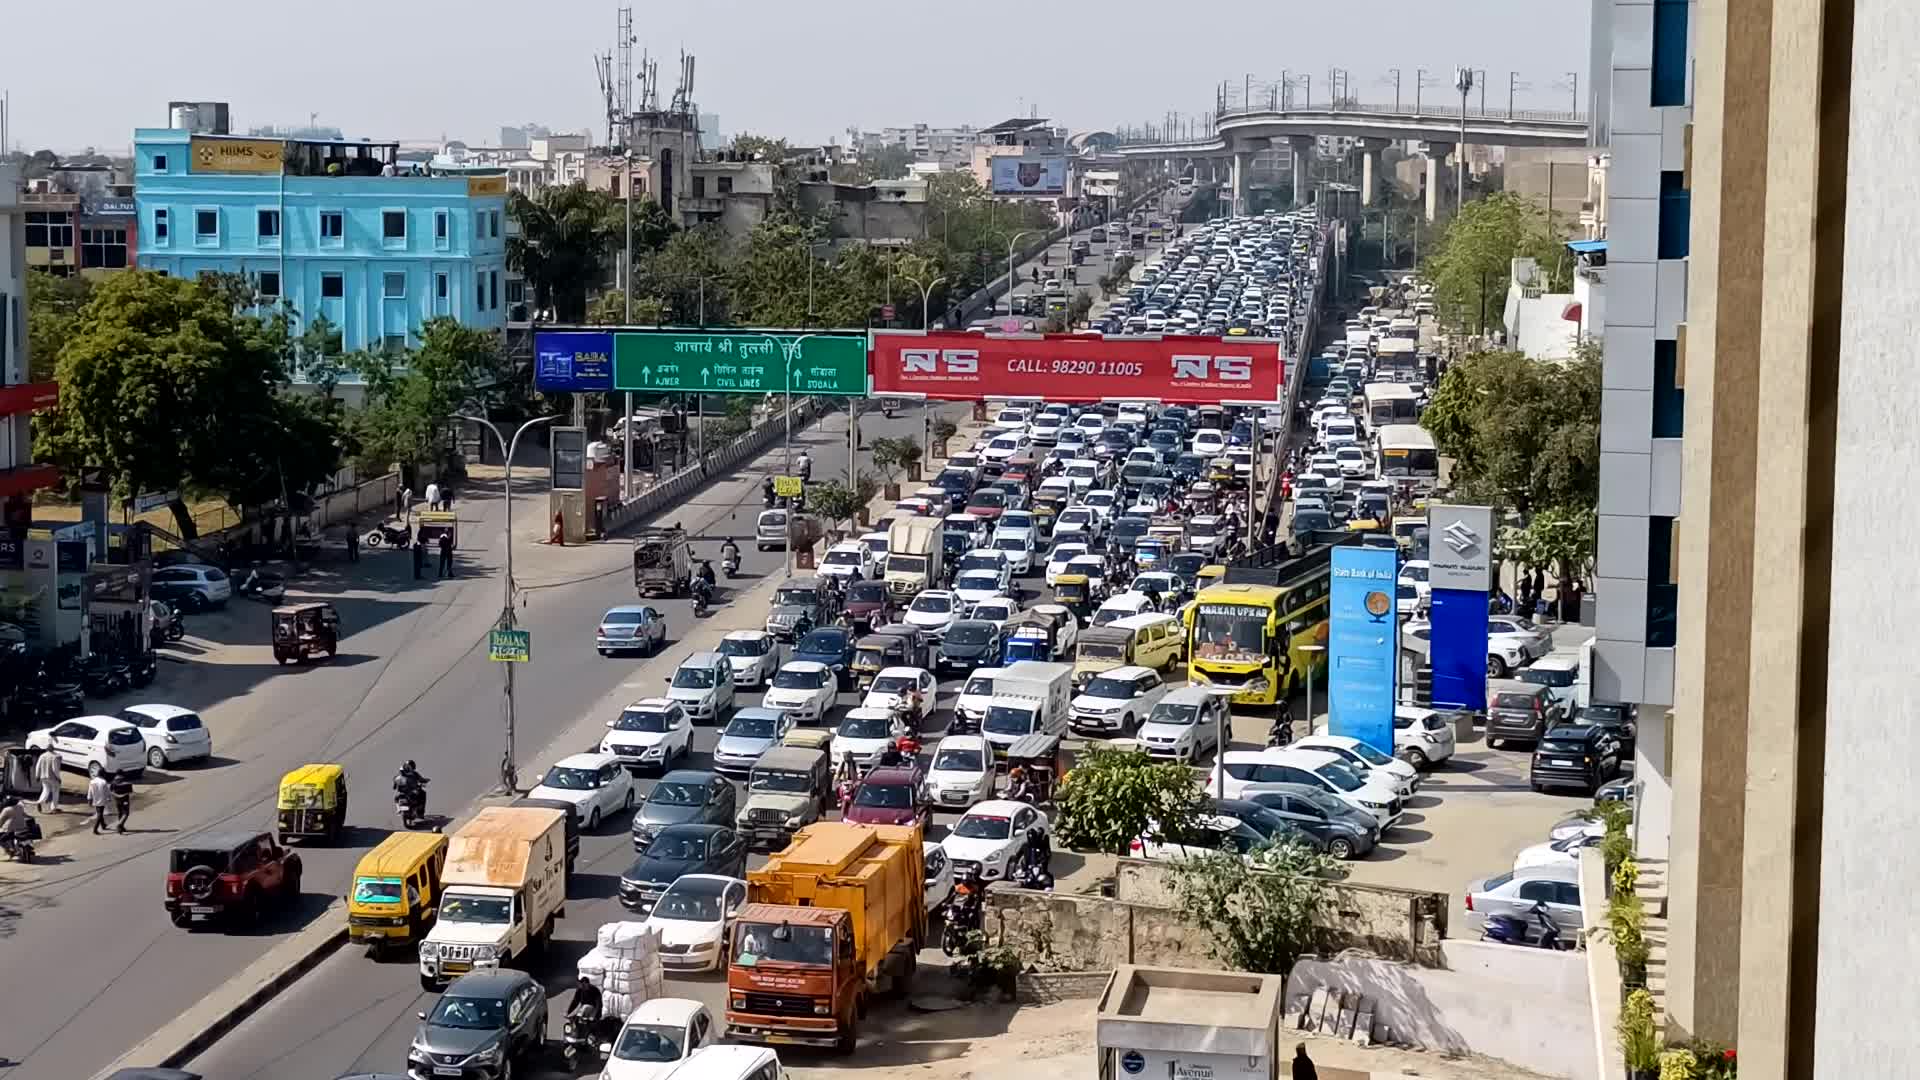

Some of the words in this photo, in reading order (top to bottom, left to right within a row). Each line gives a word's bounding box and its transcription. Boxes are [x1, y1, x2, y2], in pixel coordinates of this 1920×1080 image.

[673, 337, 713, 353] आचार्य
[718, 338, 733, 353] श्री
[739, 338, 774, 359] तुलसी
[1007, 359, 1047, 373] CALL:
[1051, 360, 1096, 374] 98290
[1098, 361, 1143, 375] 11005
[655, 377, 680, 386] AJMER
[716, 378, 736, 387] CIVIL
[739, 378, 760, 388] LINES
